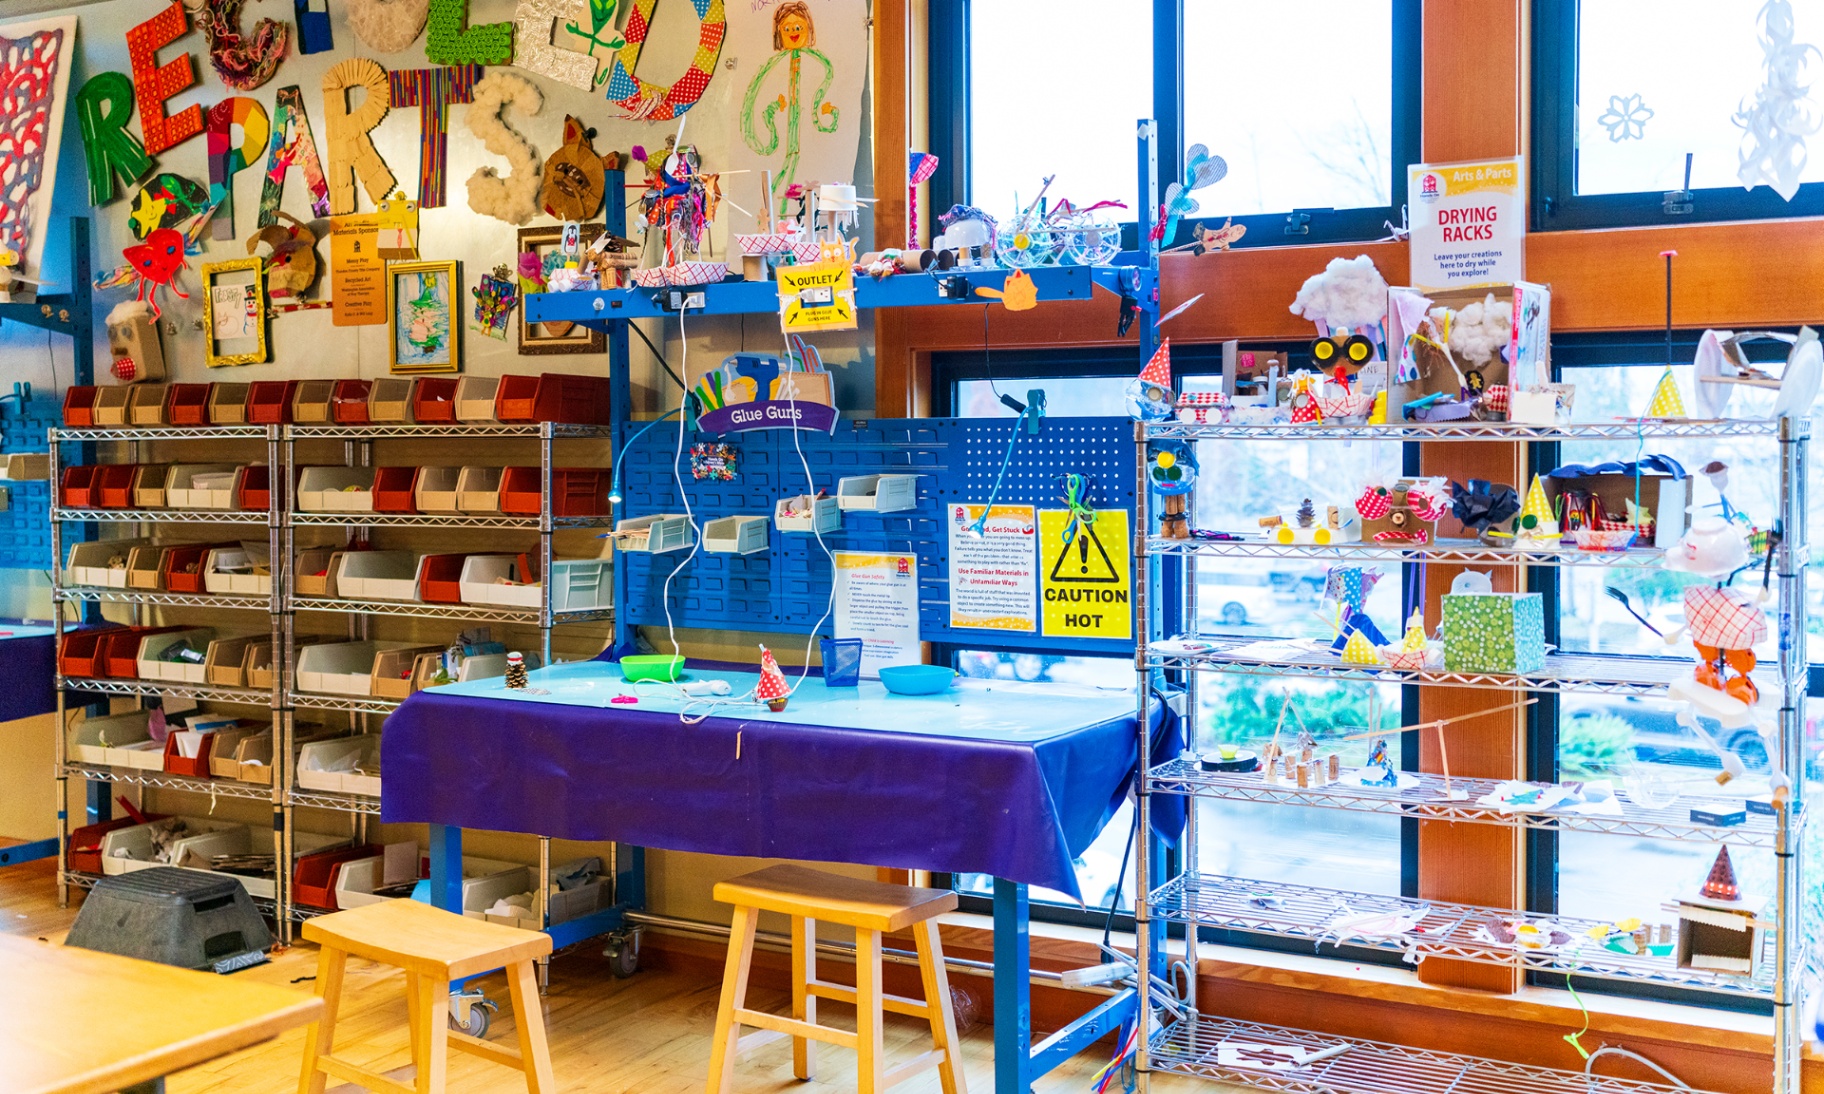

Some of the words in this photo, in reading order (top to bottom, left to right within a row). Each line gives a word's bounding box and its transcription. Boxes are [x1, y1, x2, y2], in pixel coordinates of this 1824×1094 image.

[206, 57, 545, 241] PARTS
[1453, 171, 1474, 182] Arts
[1476, 169, 1484, 180] &
[1486, 168, 1512, 180] Parts
[1438, 206, 1497, 225] DRYING
[1443, 224, 1493, 242] RACKS
[1454, 253, 1470, 261] your
[1471, 250, 1502, 258] creations
[1465, 260, 1476, 268] dry
[797, 274, 832, 286] OUTLET
[1448, 271, 1460, 279] you
[1461, 268, 1488, 278] explore!
[731, 408, 762, 424] Glue
[766, 406, 802, 420] Guns
[1044, 588, 1127, 603] CAUTION
[1065, 614, 1103, 628] HOT
